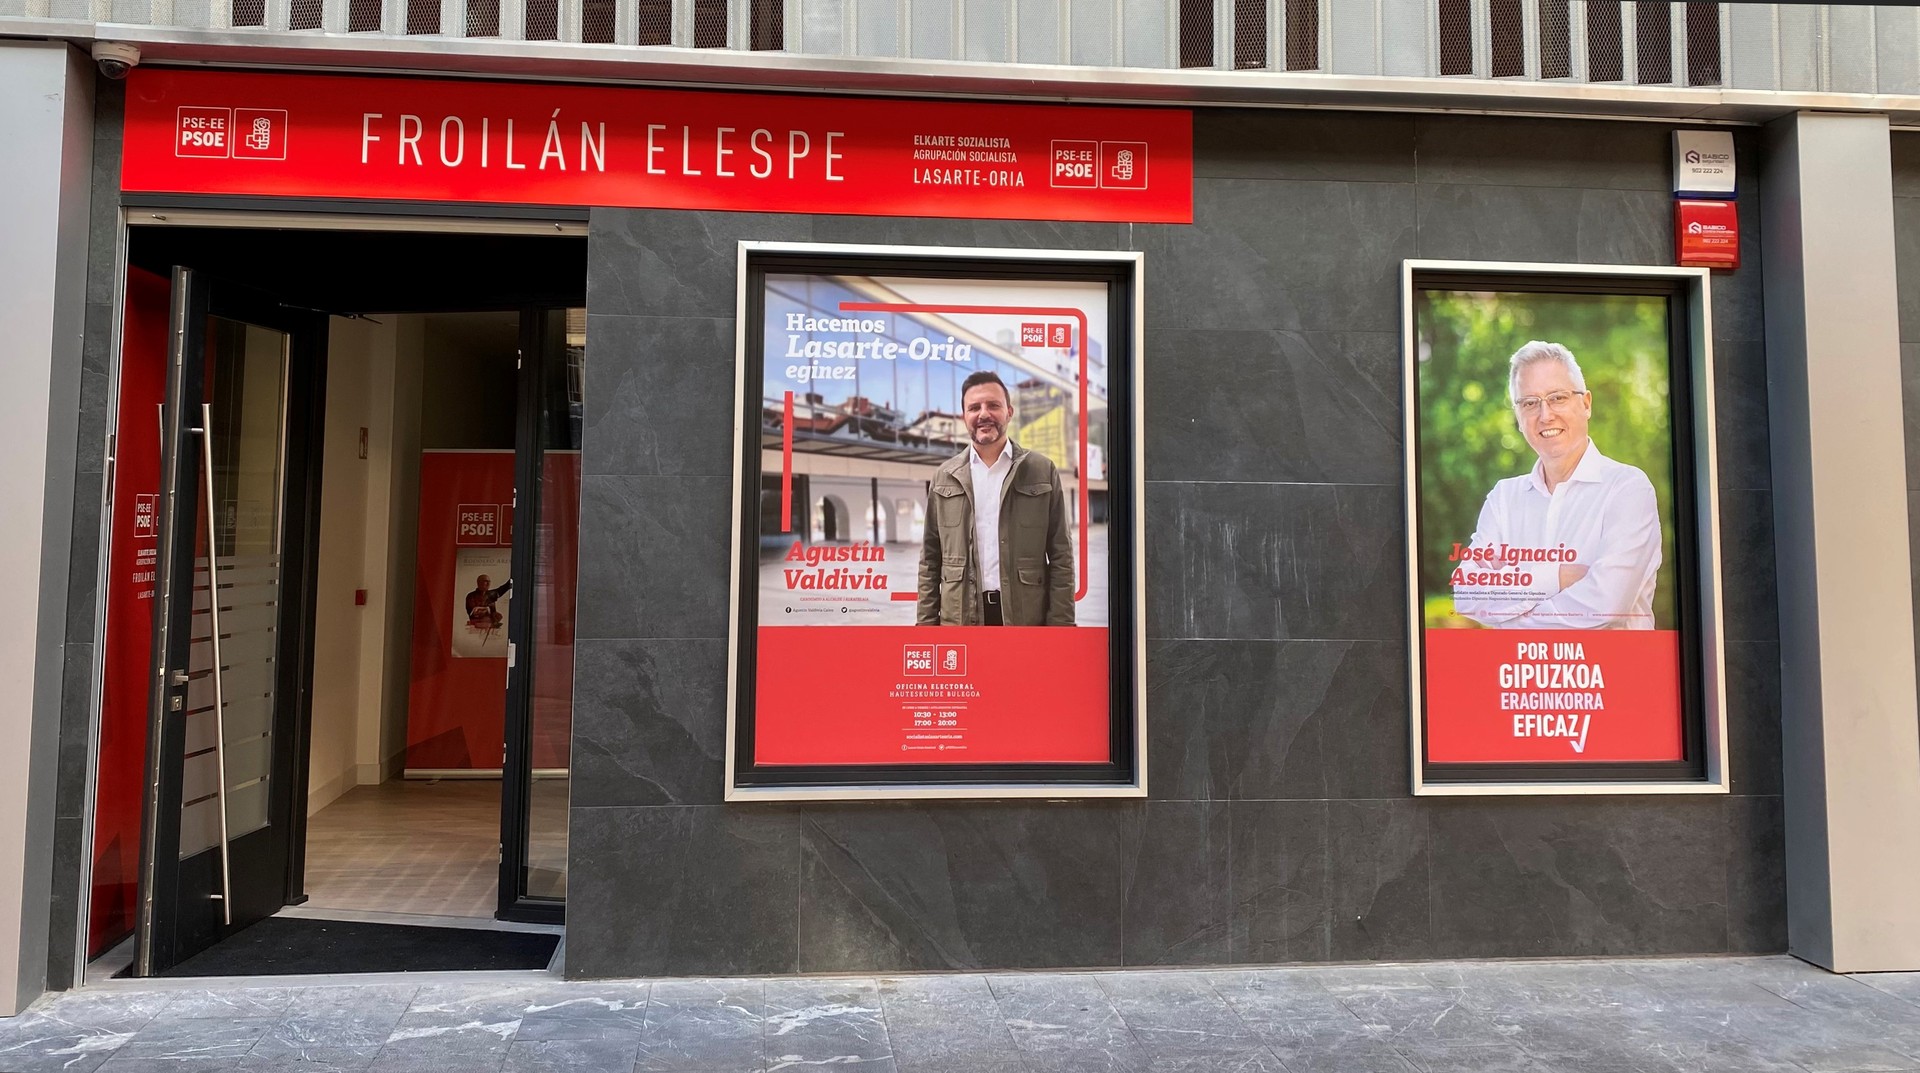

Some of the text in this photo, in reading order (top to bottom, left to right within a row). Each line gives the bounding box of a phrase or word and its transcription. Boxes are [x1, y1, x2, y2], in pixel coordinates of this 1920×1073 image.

[182, 117, 225, 130] PSE-EE
[181, 131, 225, 148] PSOE
[361, 108, 846, 181] FROILÁN ELESPE
[914, 135, 1011, 149] ELKARTE SOZIALISTA
[913, 149, 1017, 163] AGRUPACIÓN SOCIALISTA
[1055, 150, 1093, 161] PSE-EE
[913, 168, 1025, 187] LASARTE-ORIA
[1055, 163, 1093, 178] PSOE
[785, 313, 886, 333] Hacemos
[1023, 334, 1044, 343] PSOE
[785, 334, 972, 362] Lasarte-Oria
[785, 361, 857, 383] eginez
[137, 503, 152, 513] PSE-EE
[136, 515, 151, 528] PSOE
[461, 512, 494, 522] PSE-EE
[460, 523, 494, 536] PSOE
[784, 540, 886, 568] Agustín
[1448, 542, 1577, 566] José Ignacio
[783, 567, 888, 590] Valdivia
[1448, 567, 1533, 587] Asensio
[907, 651, 931, 659] PSE-EE
[1517, 642, 1586, 660] POR UNA
[907, 660, 932, 670] PSOE
[1499, 663, 1605, 689] GIPUZKOA
[1500, 692, 1605, 710] ERAGINKORRA
[1513, 714, 1579, 737] EFICAZ
